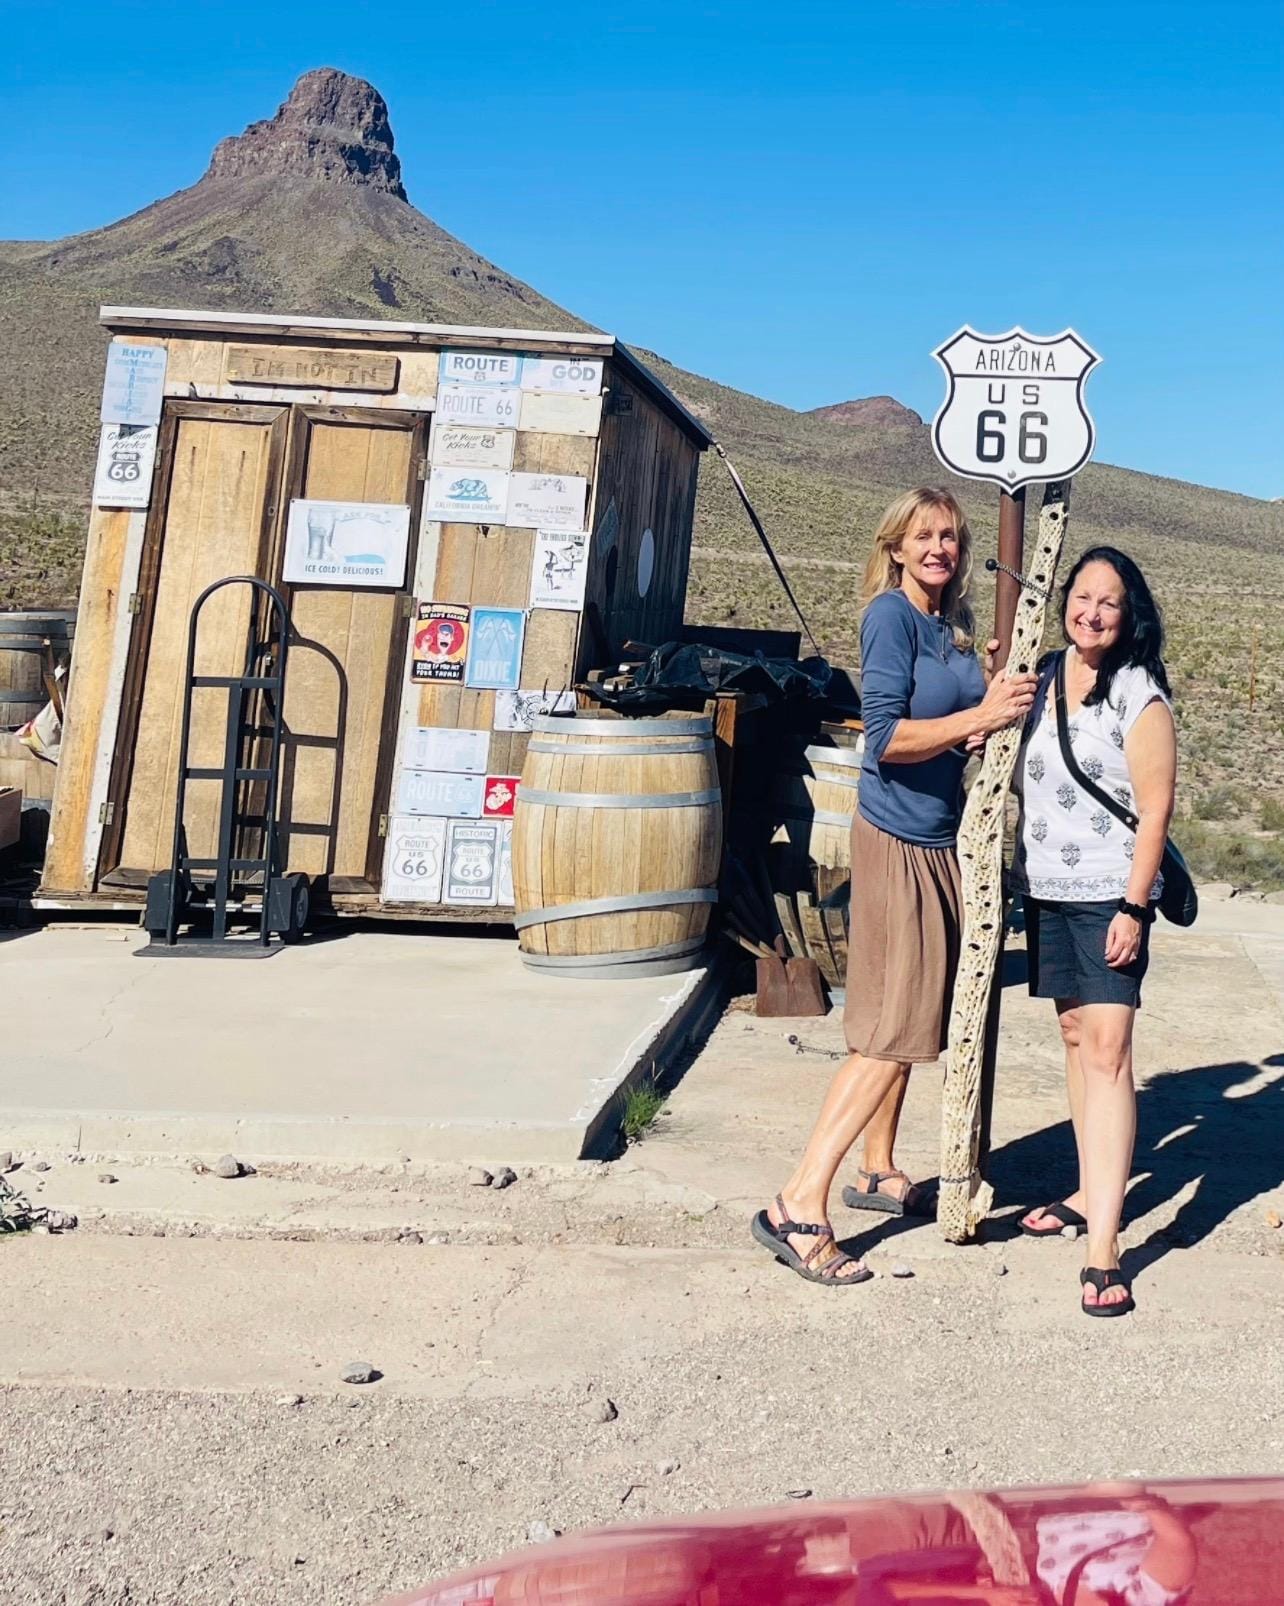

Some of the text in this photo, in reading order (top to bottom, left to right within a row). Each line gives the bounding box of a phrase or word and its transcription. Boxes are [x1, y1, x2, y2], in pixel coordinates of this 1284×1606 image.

[121, 347, 154, 359] HAPPY
[975, 349, 1056, 372] ARIZONA
[453, 356, 509, 372] ROUTE
[551, 365, 597, 381] GOD
[442, 394, 513, 416] ROUTE 66
[975, 409, 1049, 465] 66
[110, 463, 138, 480] 66
[434, 500, 470, 510] CALIFORNIA
[304, 563, 317, 573] ICE
[342, 566, 384, 577] DELICIOUS!
[474, 659, 512, 682] DIXIE
[406, 779, 455, 802] ROUTE
[455, 830, 494, 840] HISTORIC
[404, 839, 430, 849] ROUTE
[462, 847, 484, 855] ROUTE
[401, 859, 428, 876] 66
[460, 864, 483, 878] 66
[455, 887, 485, 896] ROUTE
